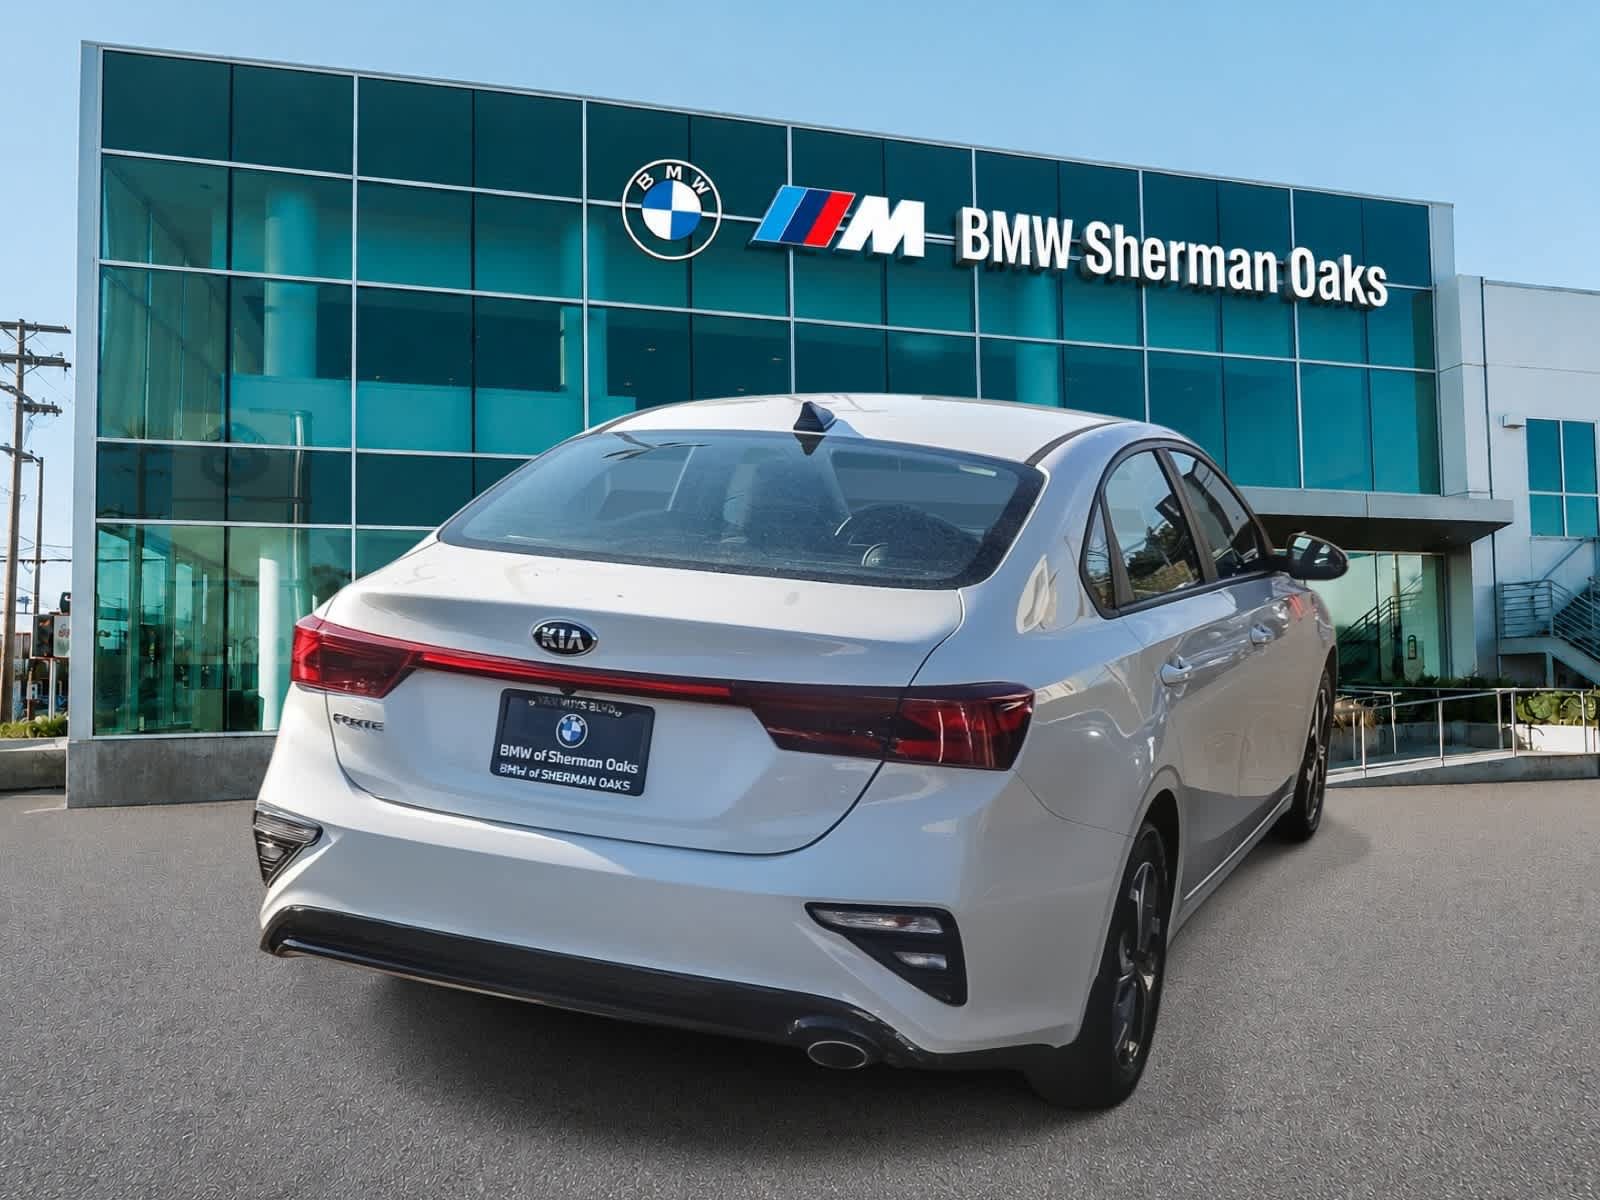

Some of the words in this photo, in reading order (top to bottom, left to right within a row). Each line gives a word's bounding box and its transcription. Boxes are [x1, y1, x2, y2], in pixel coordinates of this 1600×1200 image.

[635, 165, 712, 195] BMW
[834, 194, 926, 258] M
[960, 206, 1074, 270] BMW
[1084, 220, 1279, 293] Sherman
[1290, 246, 1388, 307] Oaks
[541, 626, 585, 650] KIA
[500, 744, 533, 760] BMW
[534, 750, 547, 761] of
[548, 750, 603, 769] Sherman
[606, 758, 639, 774] Oaks
[499, 763, 527, 776] BMW
[529, 769, 540, 778] of
[541, 769, 597, 787] SHERMAN
[599, 777, 631, 791] OAKS
